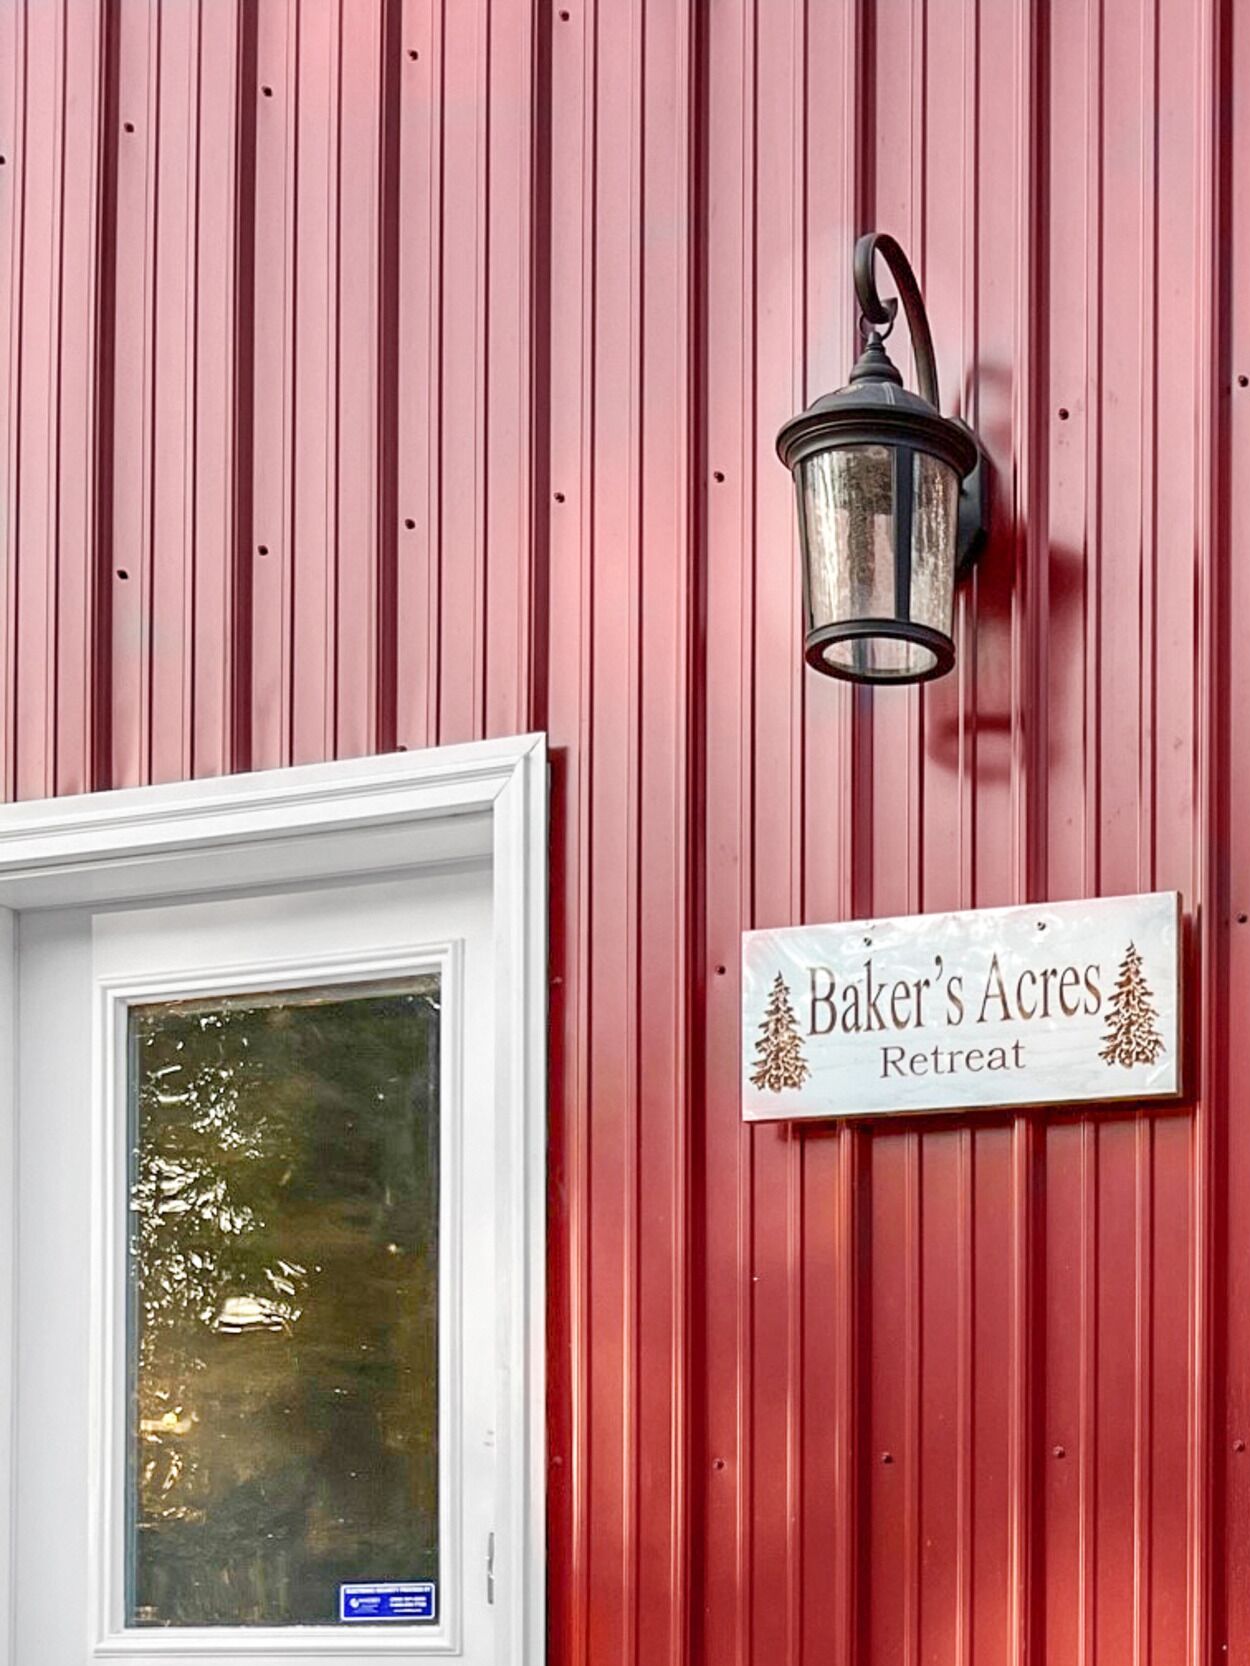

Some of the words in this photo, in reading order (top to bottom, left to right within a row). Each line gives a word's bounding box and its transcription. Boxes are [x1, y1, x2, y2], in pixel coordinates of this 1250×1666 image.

[808, 955, 964, 1035] Baker's
[977, 952, 1102, 1022] Acres
[881, 1039, 1026, 1077] Retreat
